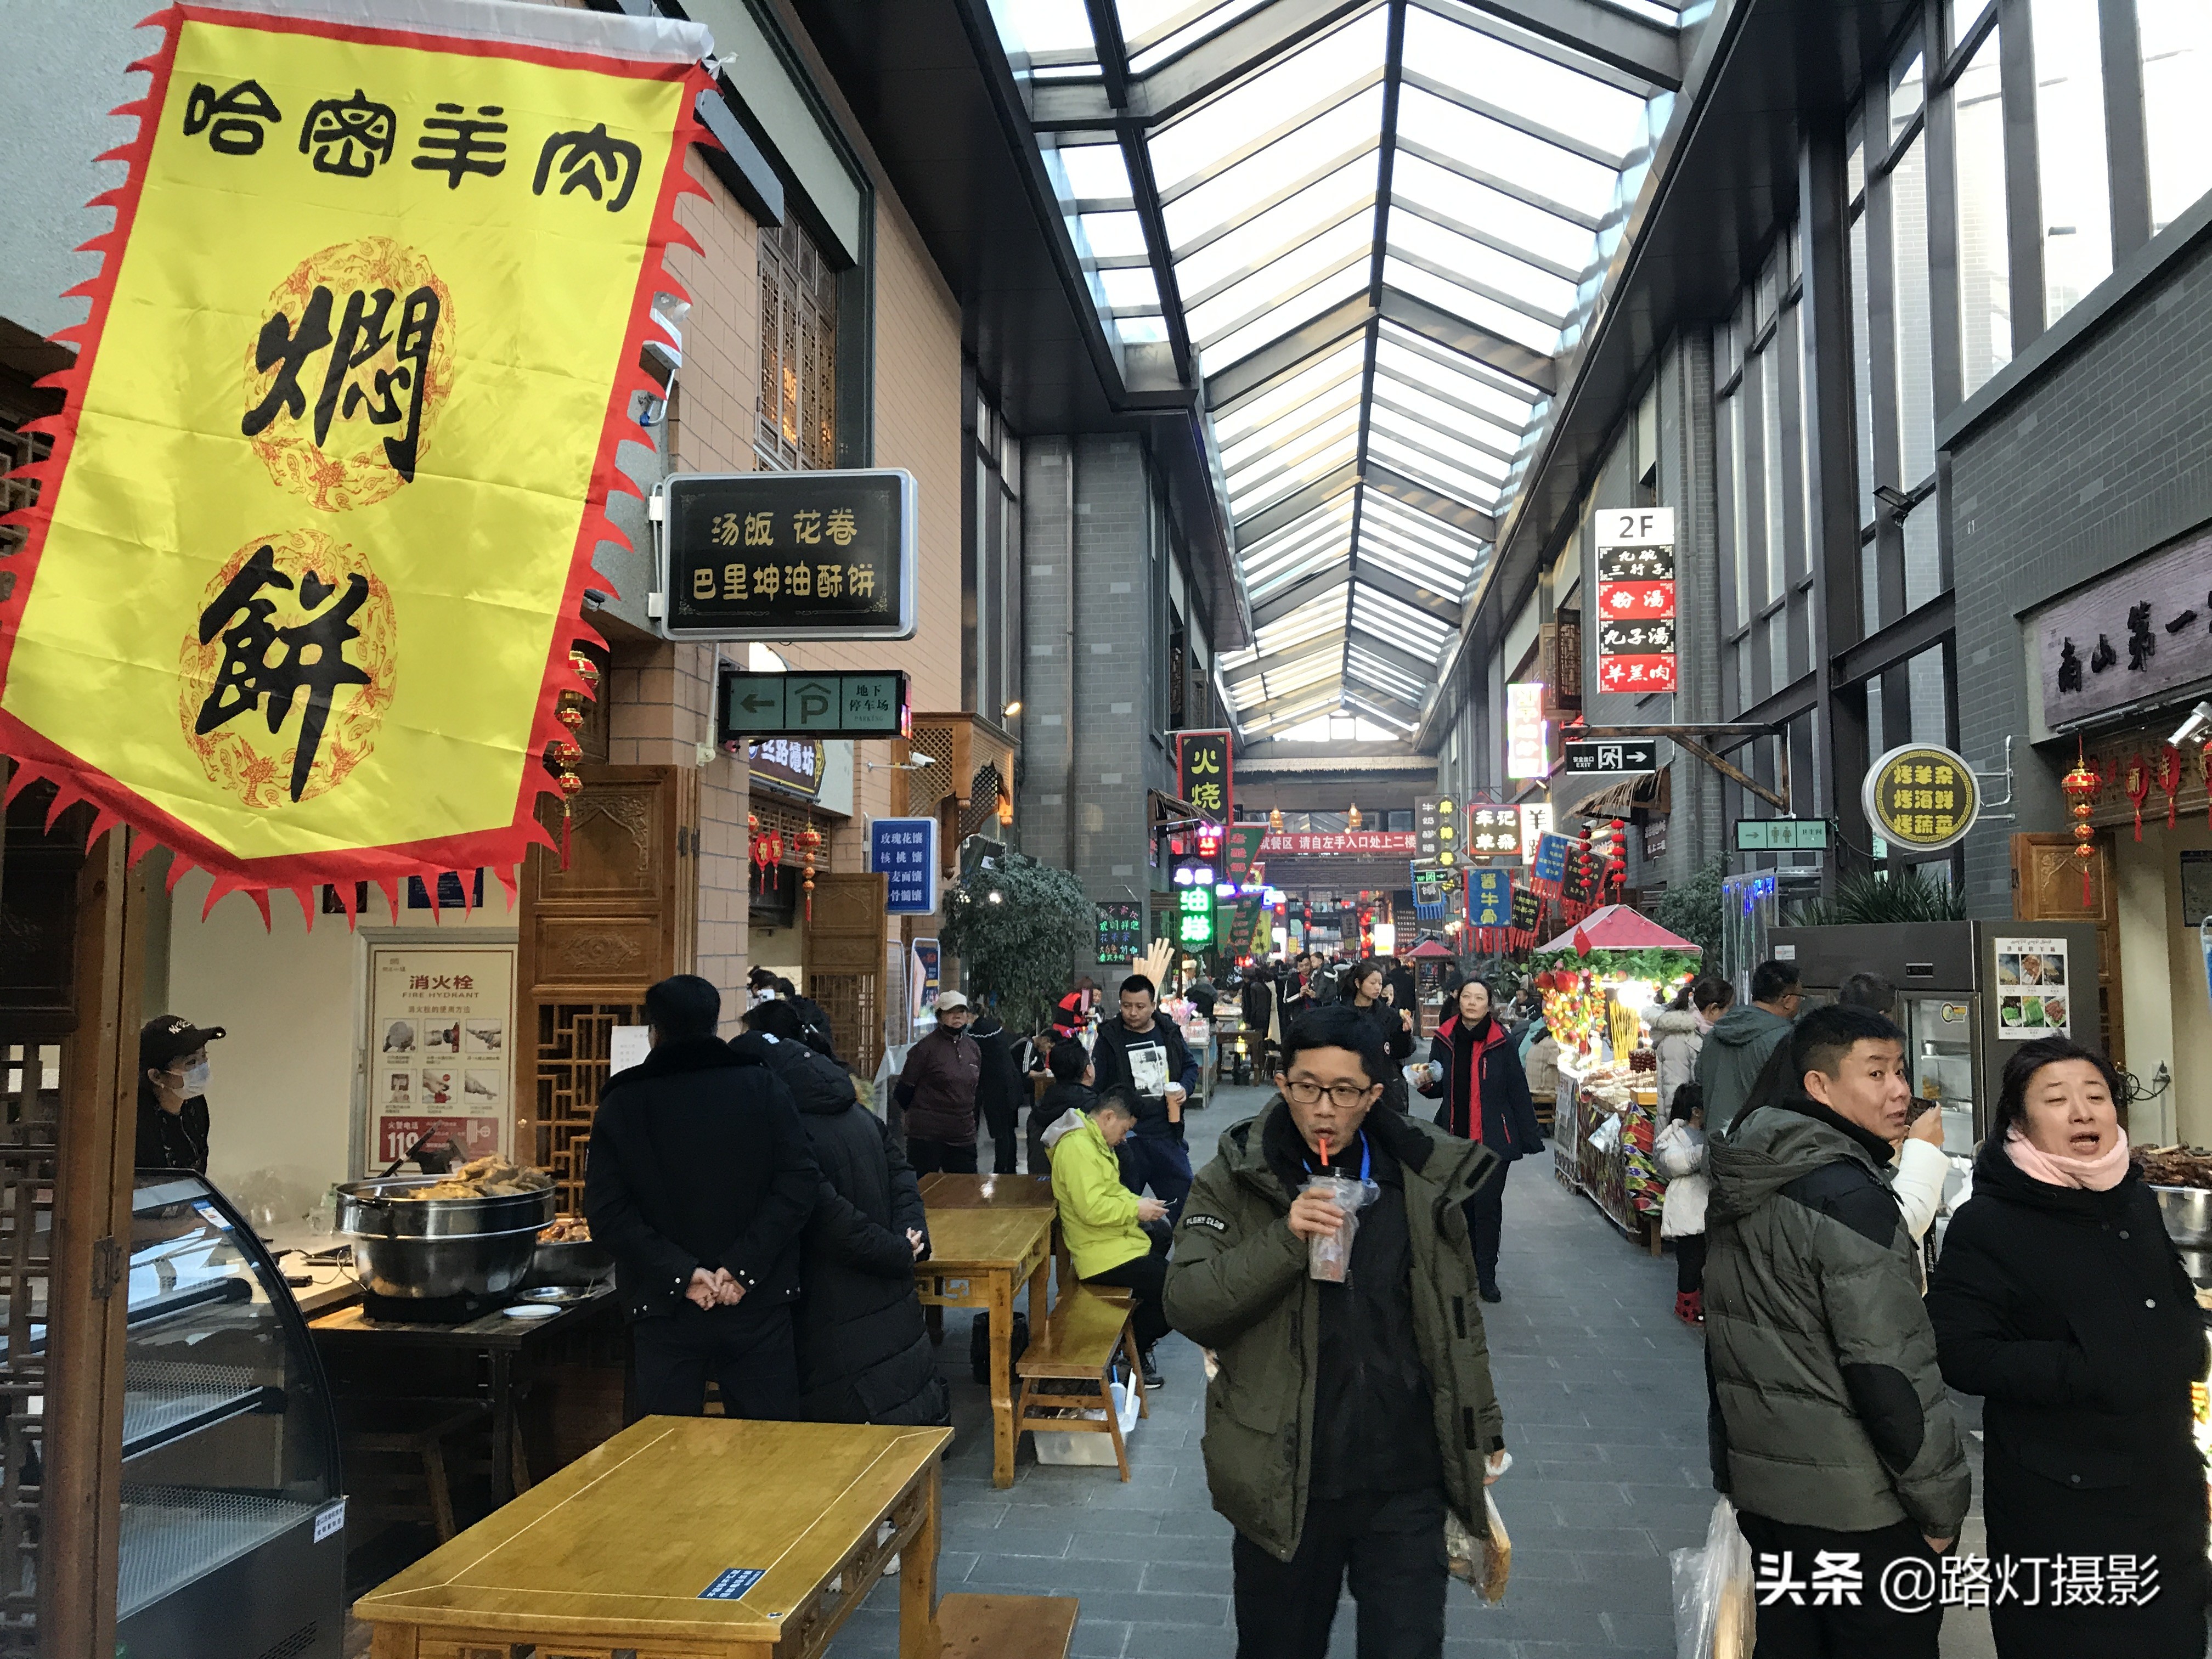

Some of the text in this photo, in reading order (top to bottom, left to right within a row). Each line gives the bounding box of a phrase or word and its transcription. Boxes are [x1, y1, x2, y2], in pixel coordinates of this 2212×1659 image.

[183, 79, 642, 212] 哈密羊肉
[711, 508, 857, 546] 汤饭 花卷
[1619, 515, 1653, 538] 2F
[693, 560, 874, 601] 巴里坤油酥饼
[195, 544, 372, 803] 餅
[1605, 664, 1670, 683] 羊羔肉
[856, 685, 882, 696] 地下
[850, 699, 888, 711] 停车场
[1191, 748, 1221, 810] 火烧
[1894, 789, 1954, 809] 烤海鲜
[1894, 814, 1954, 834] 烤蔬菜
[1299, 835, 1417, 850] 请自左手入口处上二楼
[410, 974, 473, 989] 消火栓
